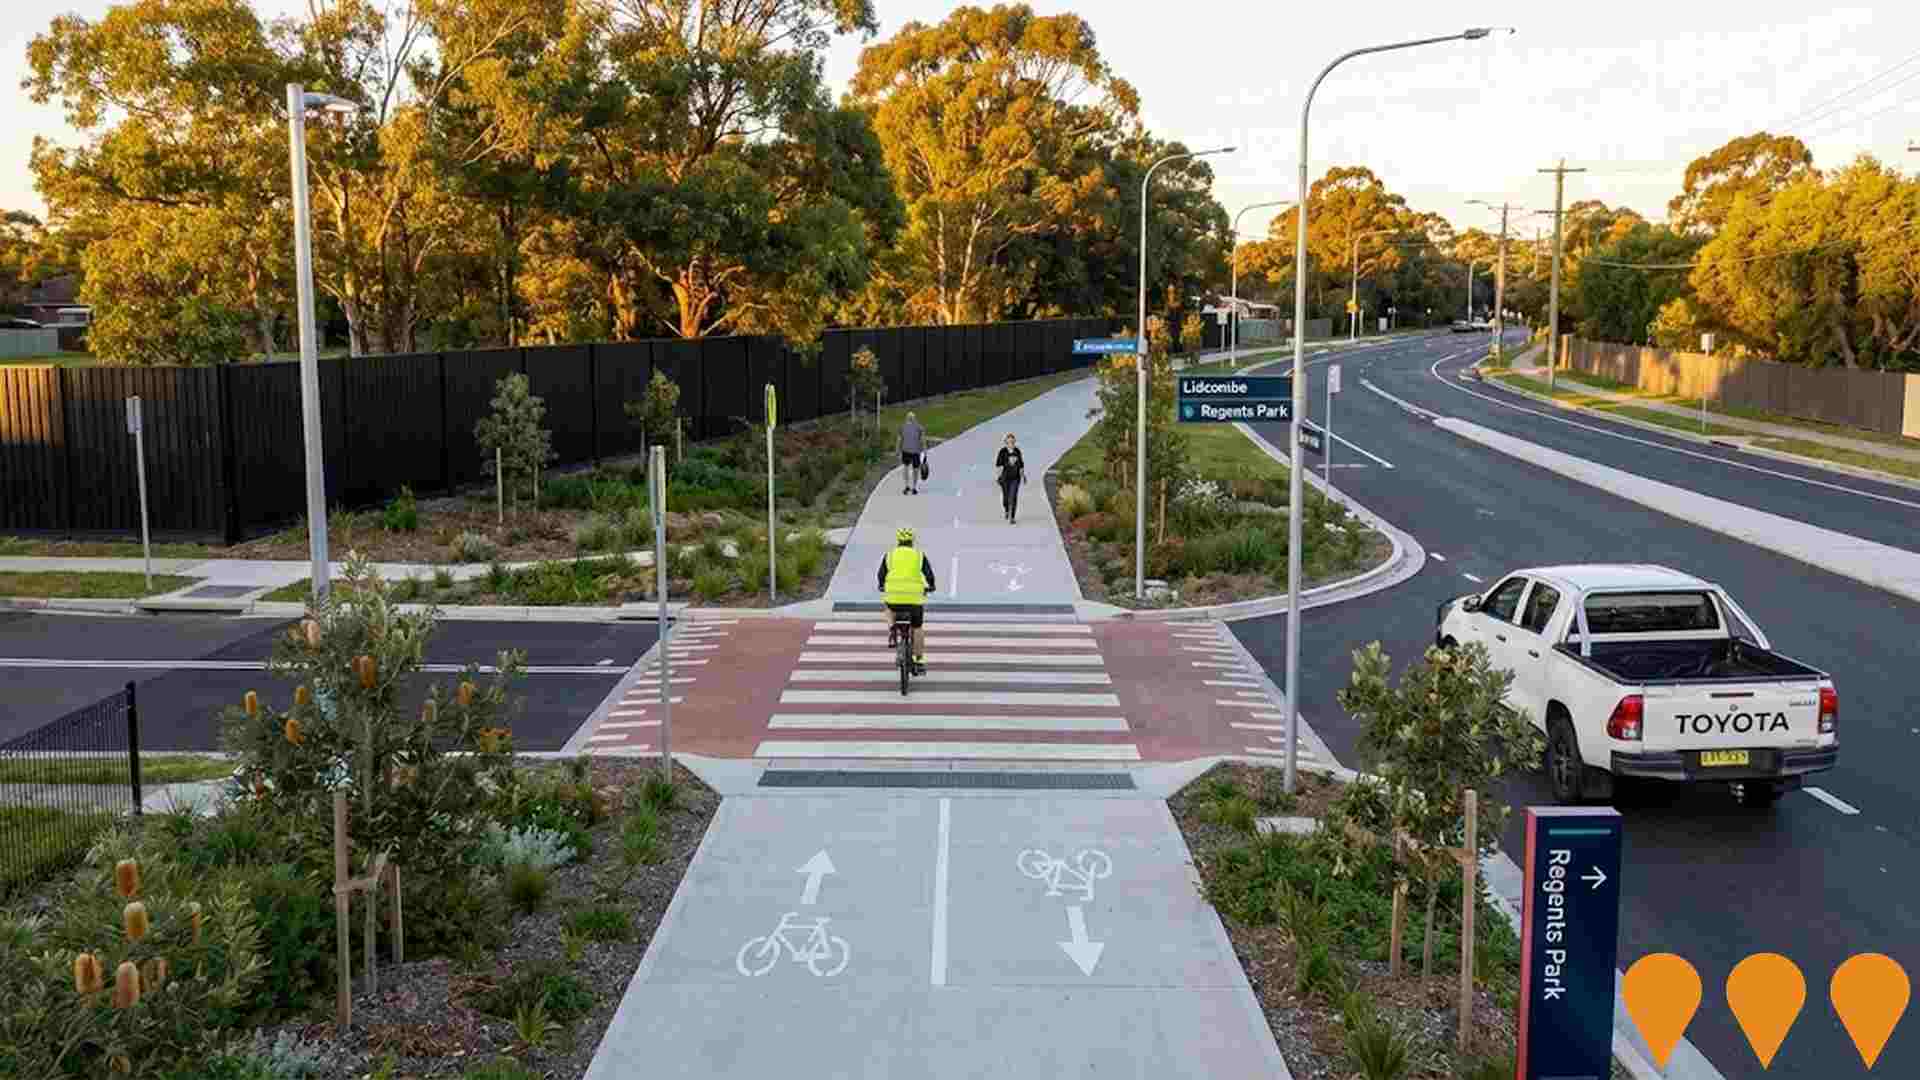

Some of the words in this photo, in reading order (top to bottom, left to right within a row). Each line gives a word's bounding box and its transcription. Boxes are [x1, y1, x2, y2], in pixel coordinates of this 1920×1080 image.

[1183, 380, 1248, 394] Lidcombe
[1201, 403, 1255, 420] Regents
[1257, 403, 1289, 418] Park
[1675, 711, 1790, 735] TOYOTA
[1542, 849, 1572, 943] Regents
[1544, 949, 1567, 1001] Park
